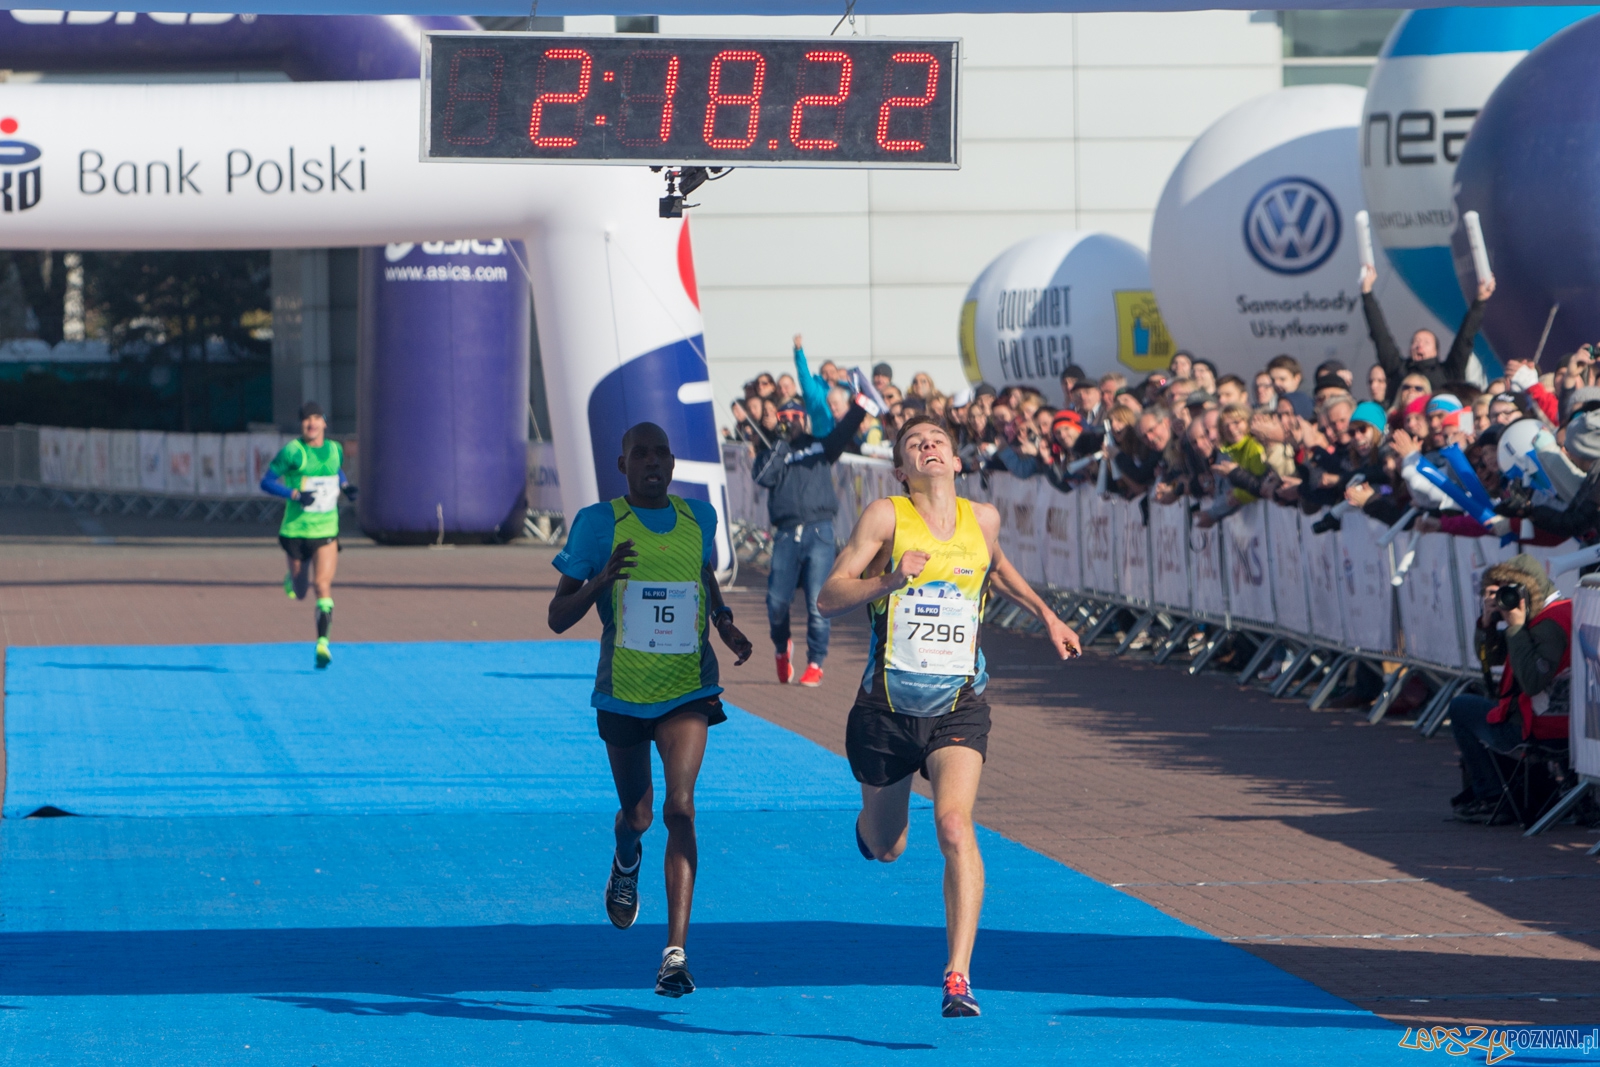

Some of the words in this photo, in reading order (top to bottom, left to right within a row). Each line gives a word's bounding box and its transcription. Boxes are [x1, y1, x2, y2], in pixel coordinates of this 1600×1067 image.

[77, 147, 203, 195] Bank
[226, 145, 366, 195] Polski
[384, 262, 508, 281] www.asics.com
[1236, 290, 1357, 314] Samochody
[1250, 317, 1348, 340] Użytkowe
[653, 605, 675, 623] 16
[907, 621, 965, 644] 7296
[918, 646, 954, 656] Christopher
